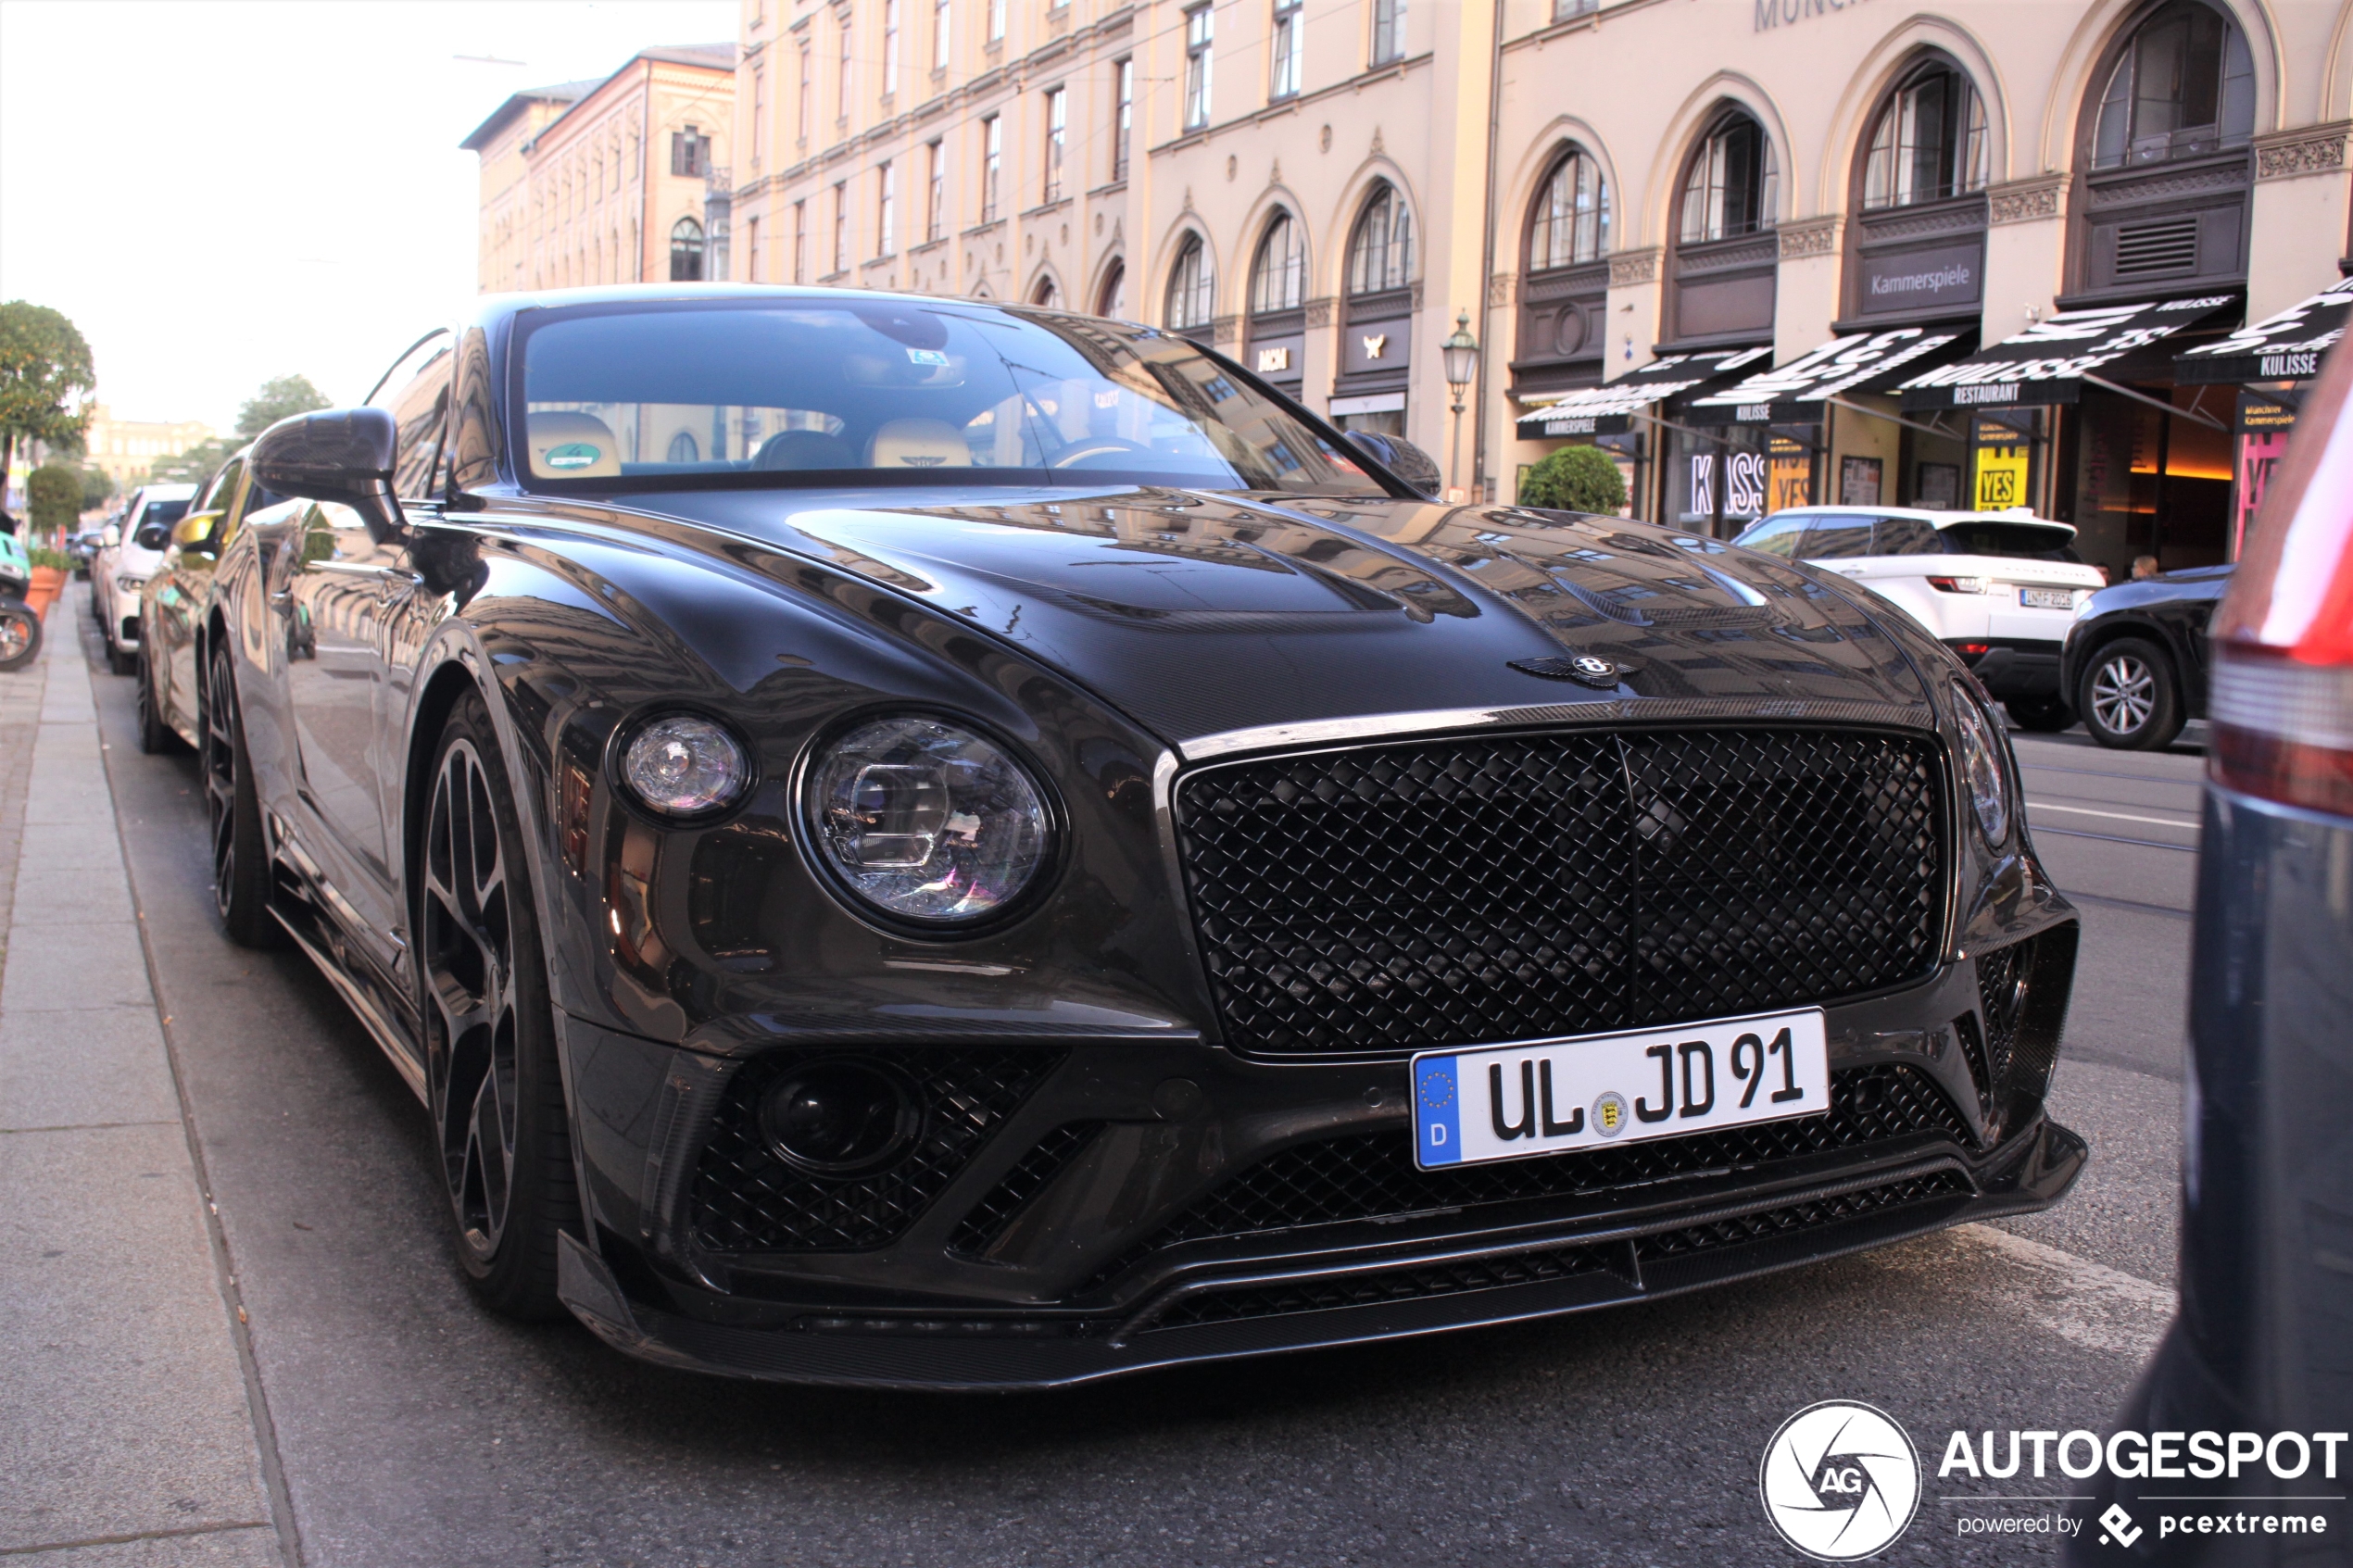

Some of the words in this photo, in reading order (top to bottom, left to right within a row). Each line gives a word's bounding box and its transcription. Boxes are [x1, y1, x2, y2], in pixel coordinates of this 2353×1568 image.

[1871, 263, 1969, 295] Kammerspiele
[1258, 347, 1289, 372] MCM
[2260, 353, 2318, 376] KULISSE
[1954, 383, 2020, 405] RESTAURANT
[1736, 404, 1770, 421] KULISSE
[2245, 405, 2282, 415] Münchner
[2245, 414, 2296, 426] Kammerspiele
[1545, 418, 1596, 435] KAMMERSPIELE
[1982, 470, 2014, 501] YES
[1430, 1123, 1447, 1147] D
[1489, 1059, 1585, 1141] UL
[1634, 1040, 1715, 1123] JD
[1730, 1026, 1804, 1110] 91
